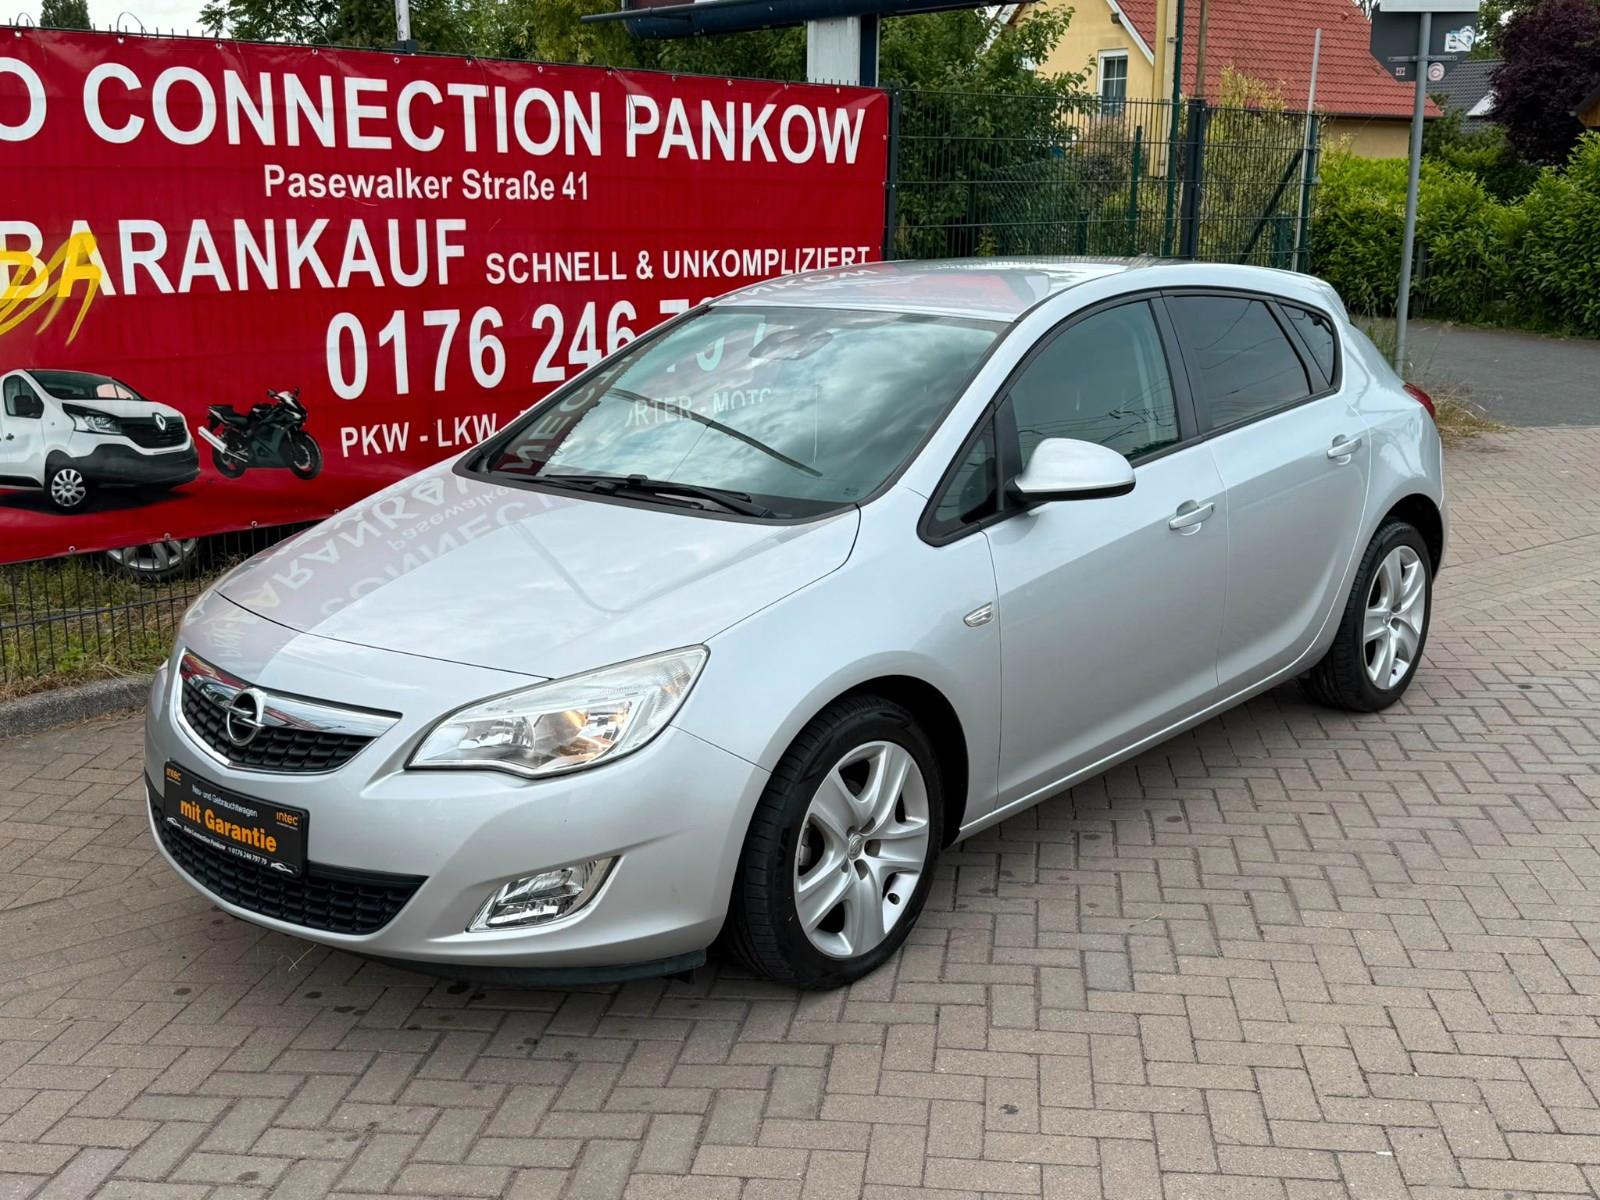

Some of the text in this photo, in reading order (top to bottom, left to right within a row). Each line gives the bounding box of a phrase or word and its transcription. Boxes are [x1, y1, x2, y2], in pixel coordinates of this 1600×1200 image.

[83, 62, 602, 156] CONNECTION
[625, 94, 866, 164] PANKOW
[264, 164, 588, 201] Pasewalker Straße 41
[0, 218, 467, 300] BARANKAUF
[486, 246, 870, 285] SCHNELL & UNKOMPLIZIERT
[326, 305, 507, 400] 0176
[340, 422, 410, 458] PKW
[437, 412, 497, 448] LKW
[180, 799, 277, 852] mit Garantie
